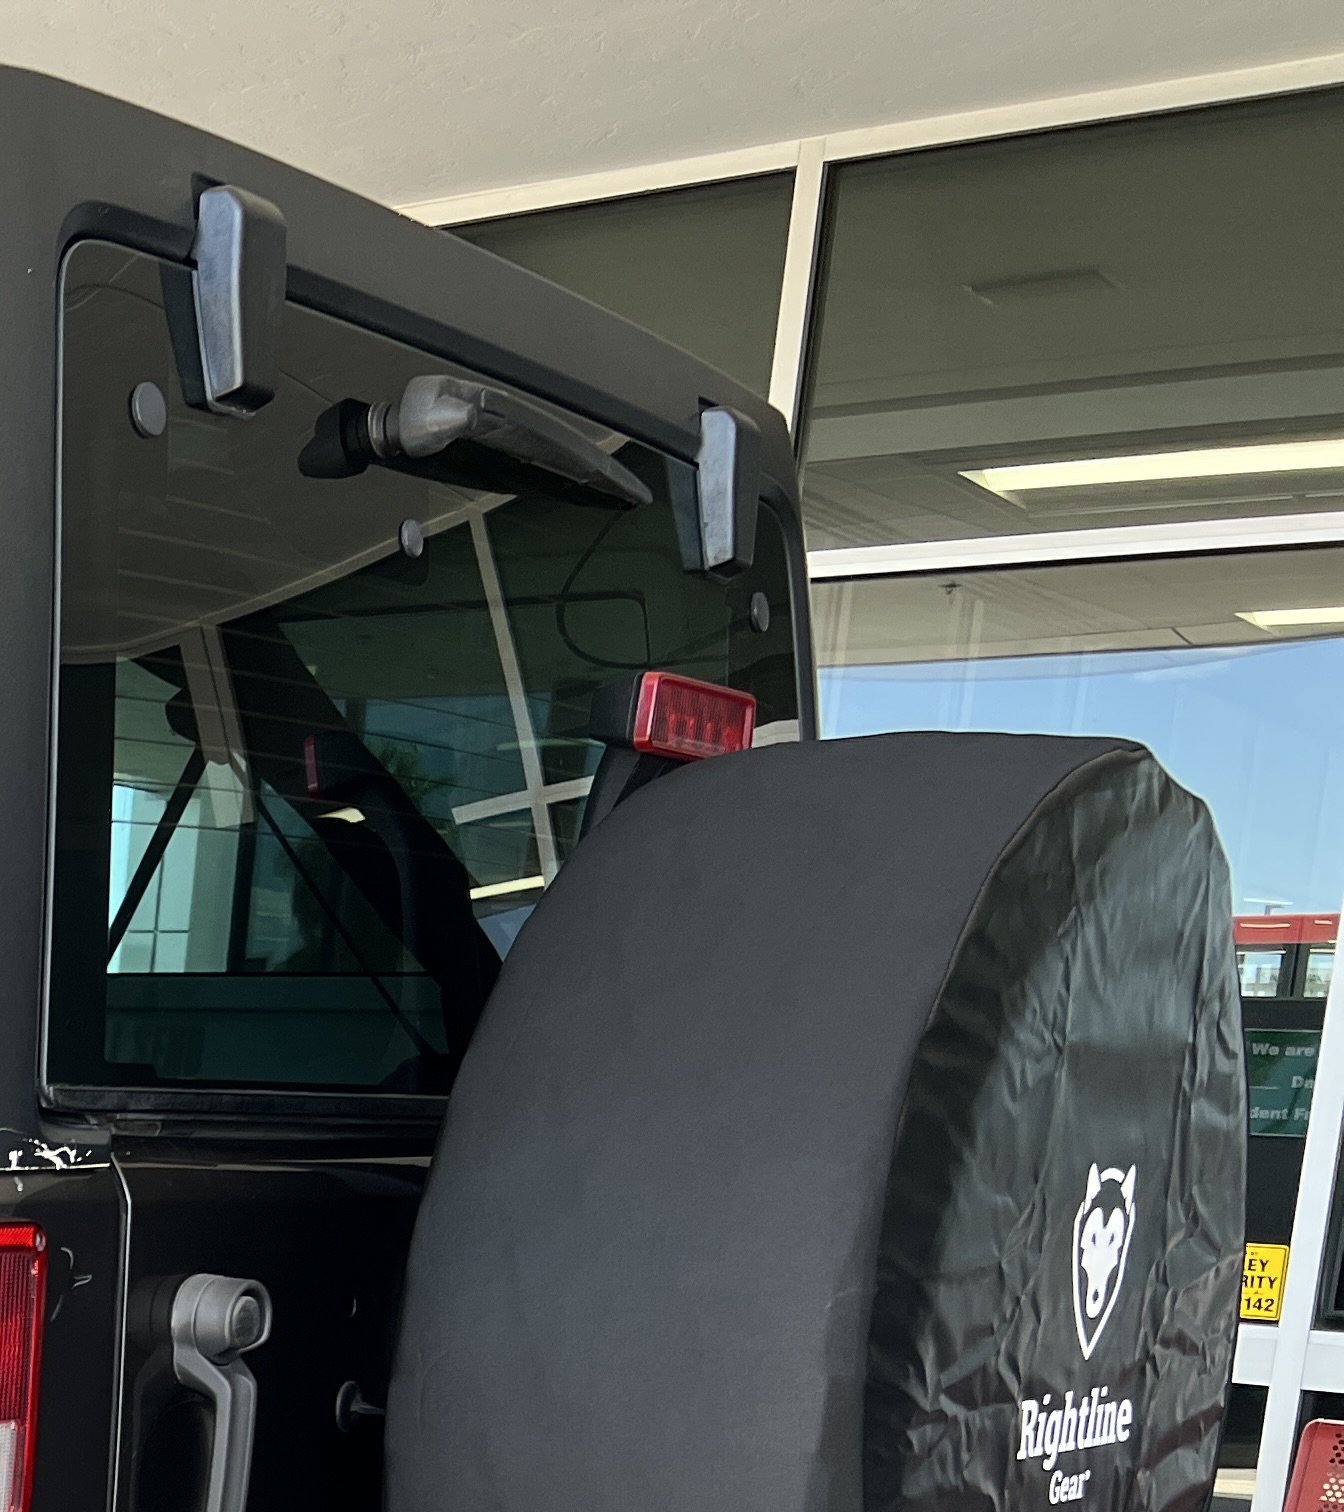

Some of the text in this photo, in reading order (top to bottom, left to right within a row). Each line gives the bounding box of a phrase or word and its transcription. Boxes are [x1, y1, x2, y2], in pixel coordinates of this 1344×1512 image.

[1252, 1043, 1315, 1057] We are
[1244, 1297, 1275, 1312] 142
[1016, 1385, 1133, 1471] Rightline
[1049, 1469, 1091, 1505] Gear
